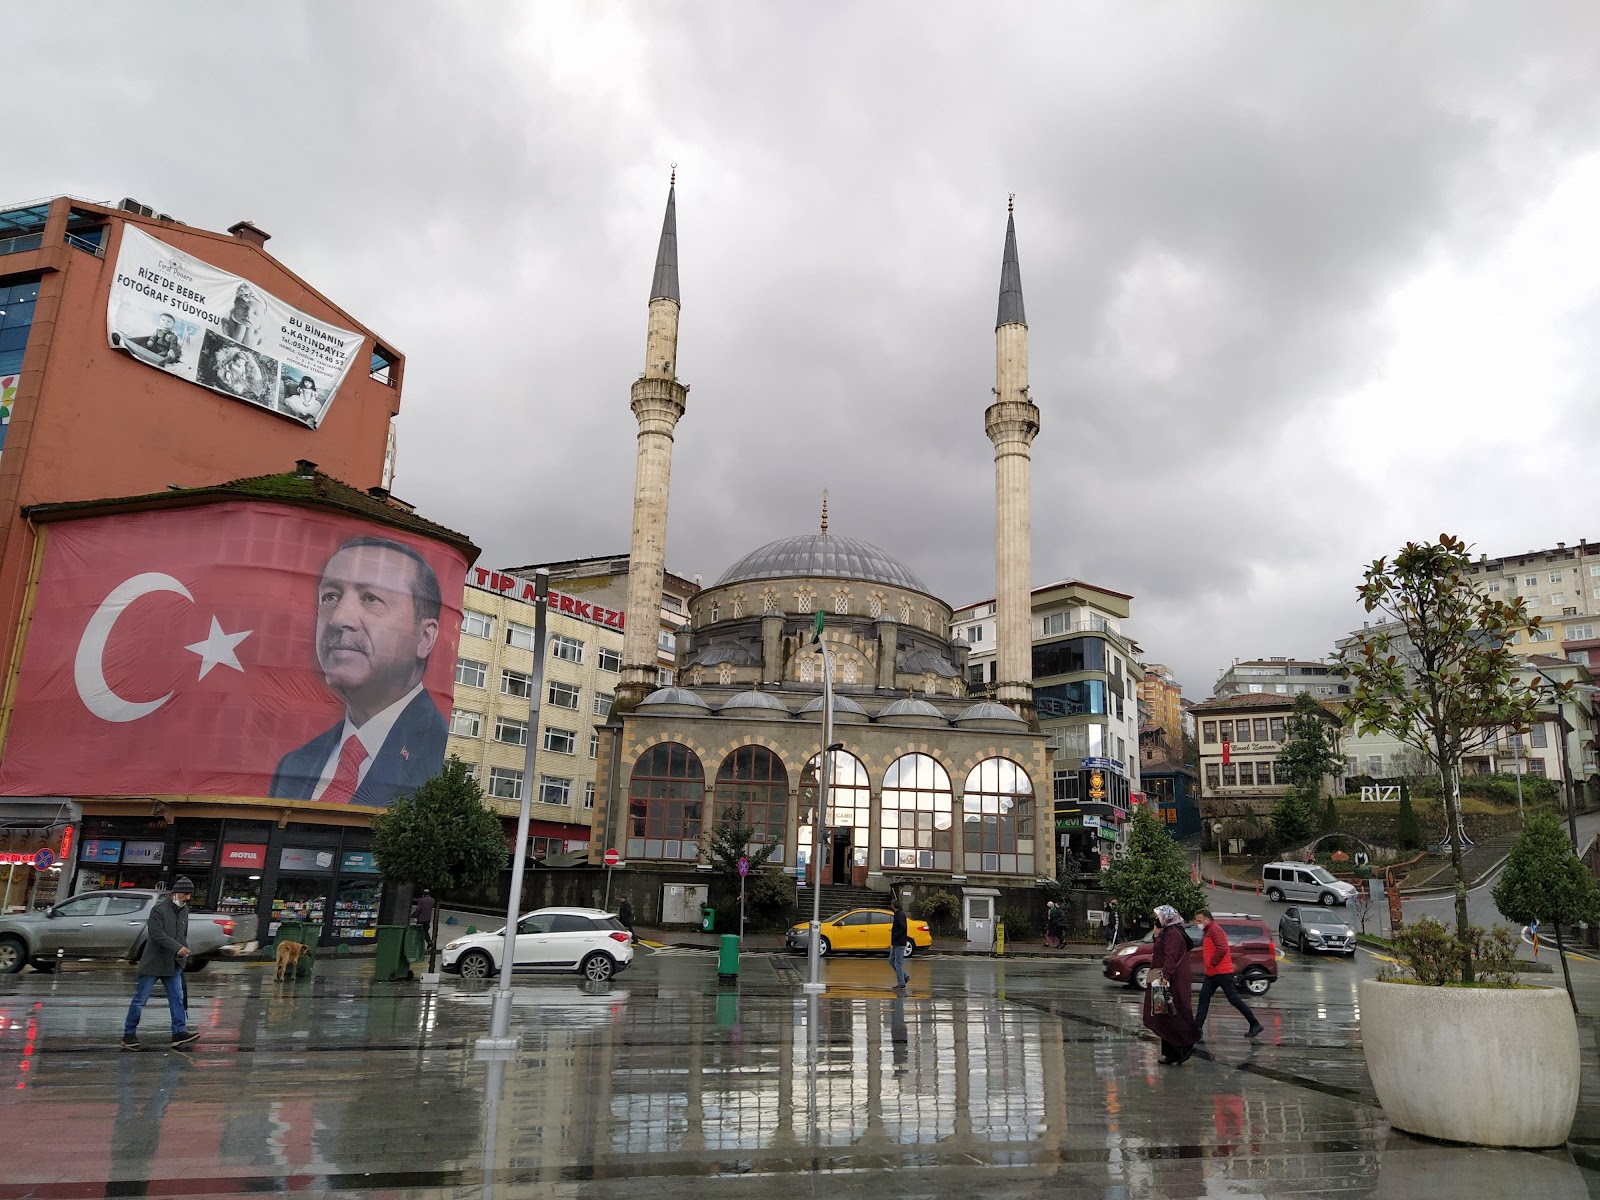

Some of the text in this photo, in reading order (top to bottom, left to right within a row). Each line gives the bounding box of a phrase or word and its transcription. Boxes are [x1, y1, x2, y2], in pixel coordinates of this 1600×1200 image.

[117, 273, 169, 303] FOTOĞRAF
[170, 297, 220, 325] STÜDYOSU
[138, 266, 175, 292] RİZE'DE
[176, 284, 206, 305] BEBEK
[281, 325, 348, 360] 6.KATINDAYIZ.
[289, 316, 344, 348] BU BİNANIN
[311, 349, 323, 359] 714
[324, 355, 333, 363] 40
[475, 566, 516, 592] TIP
[229, 851, 257, 859] MOTUL
